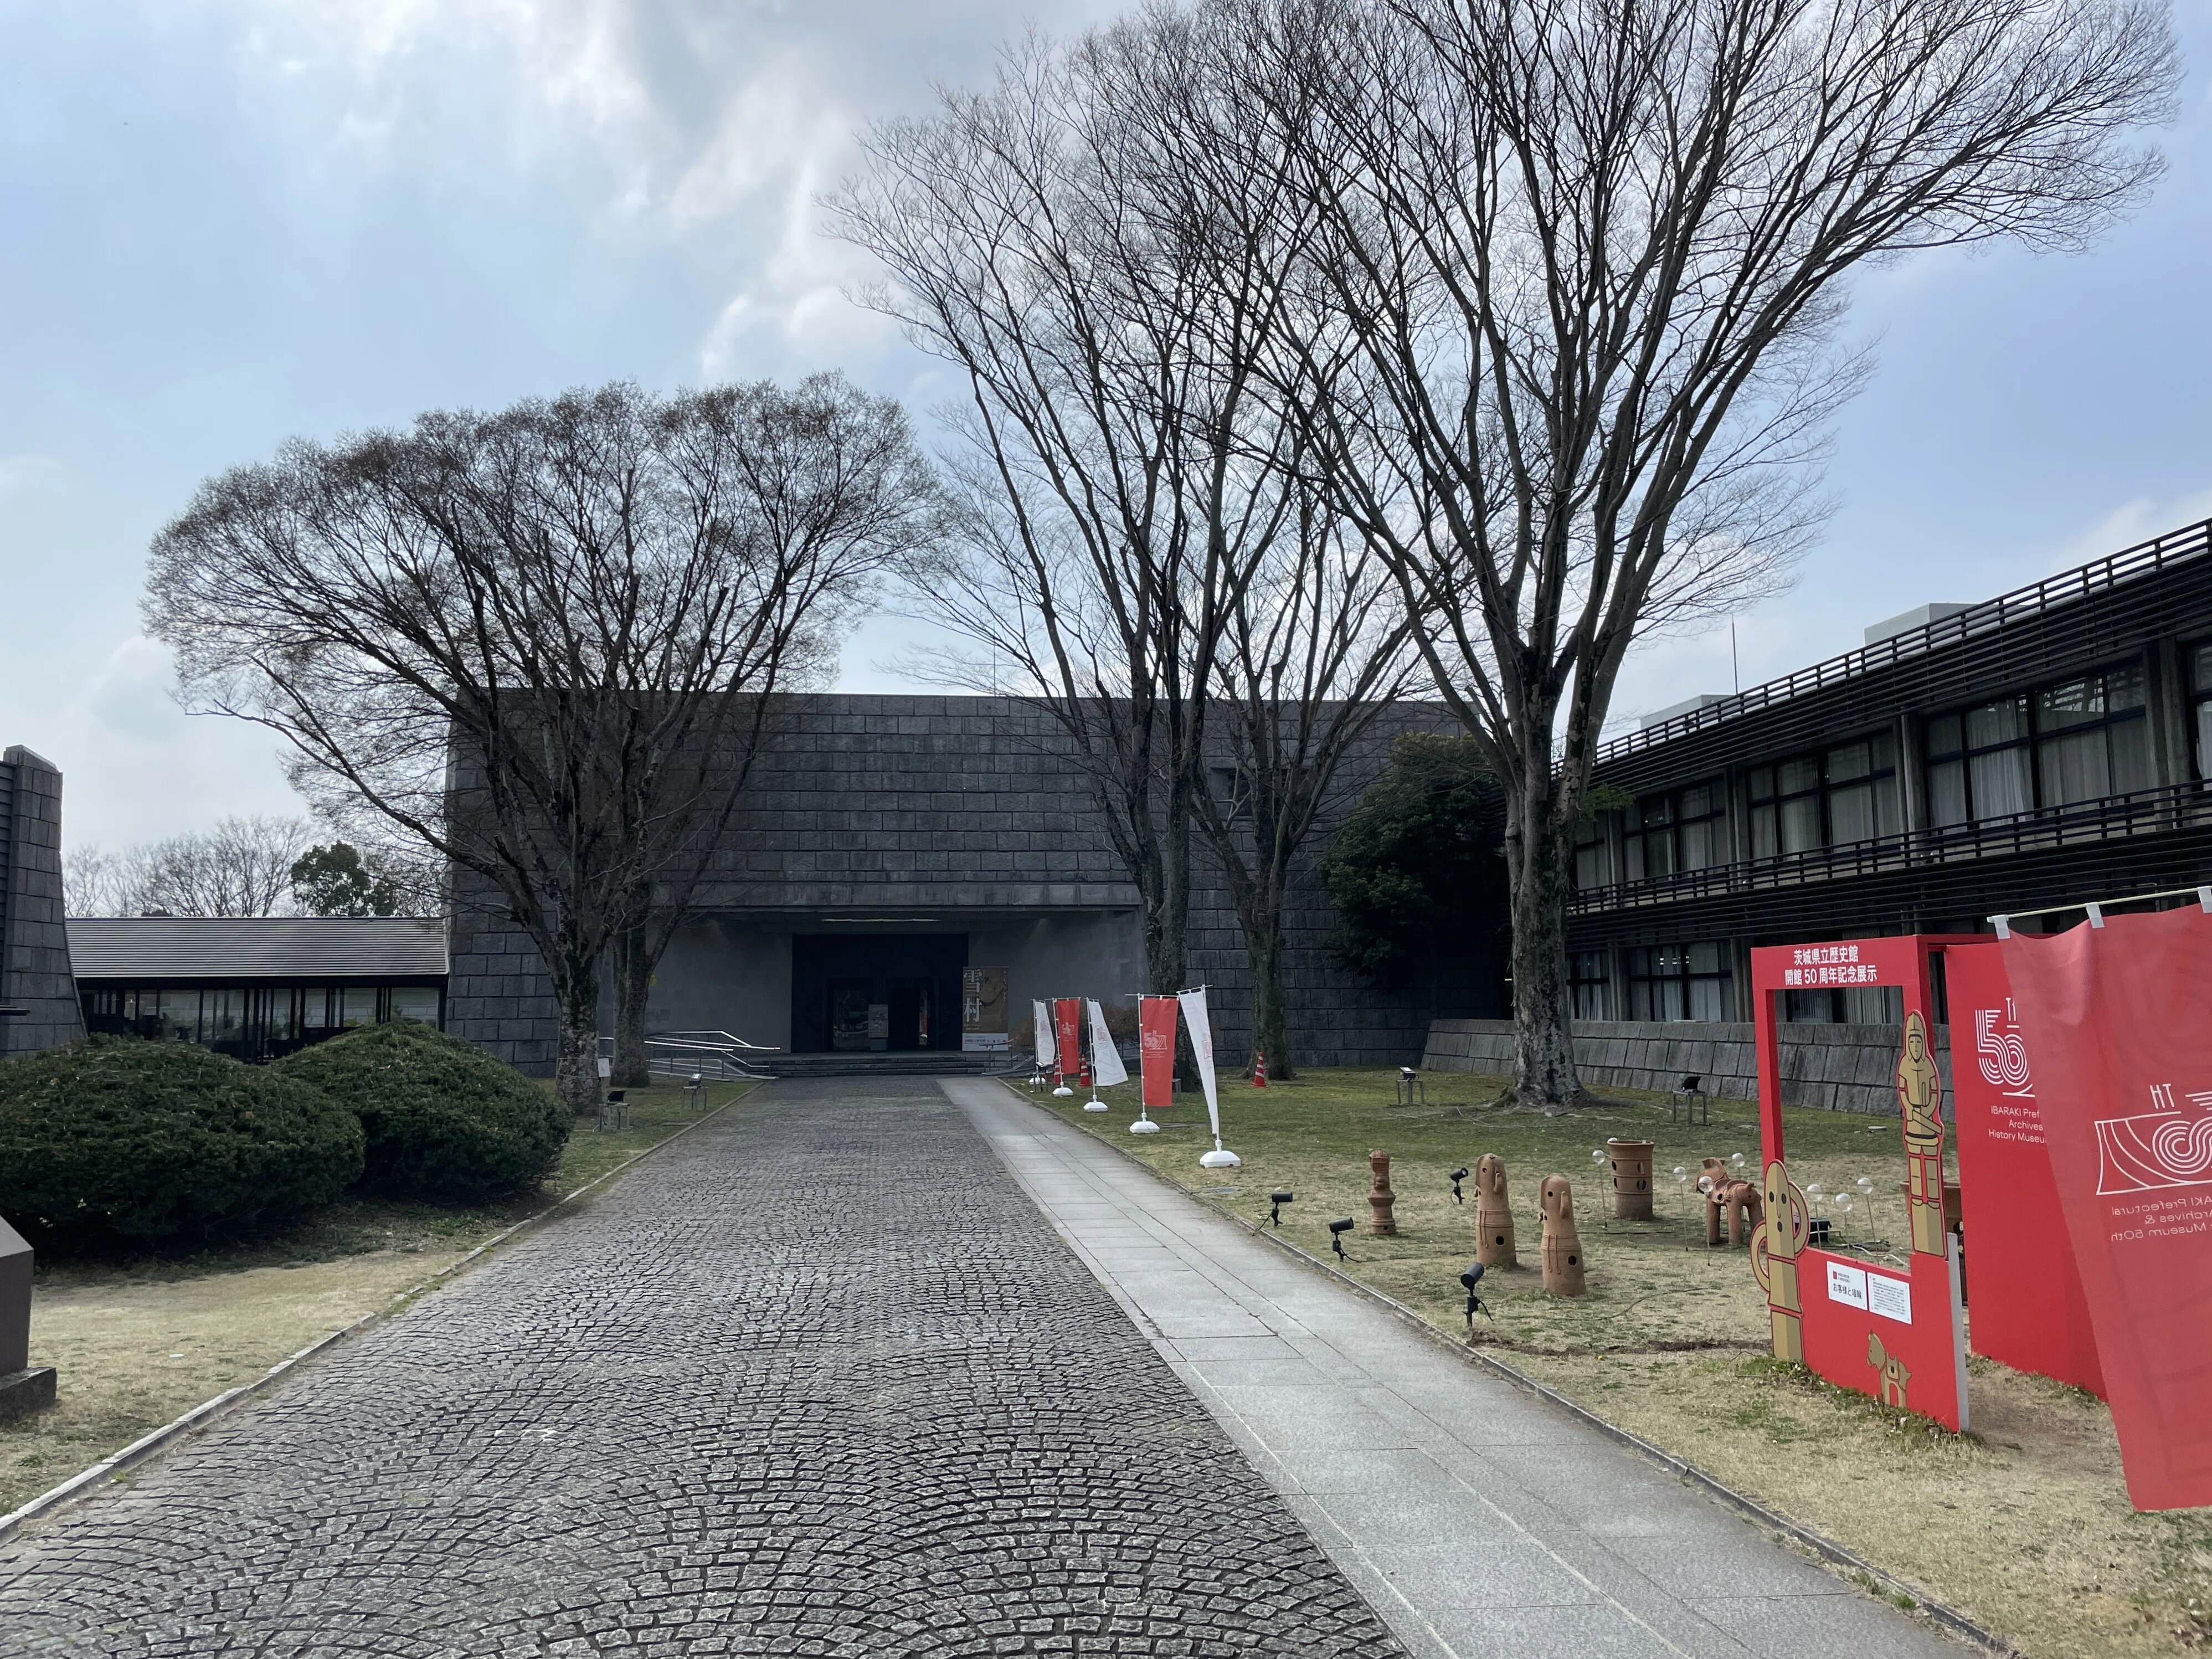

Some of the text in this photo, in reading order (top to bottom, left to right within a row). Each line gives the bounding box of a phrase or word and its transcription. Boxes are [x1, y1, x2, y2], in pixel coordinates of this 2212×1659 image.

[1794, 945, 1858, 965] 茨城県立歴史館
[964, 969, 982, 1022] 雪村
[1990, 1105, 2040, 1119] IBARAKI Pref
[2008, 1119, 2044, 1131] Archives
[1988, 1129, 2046, 1144] History Museu
